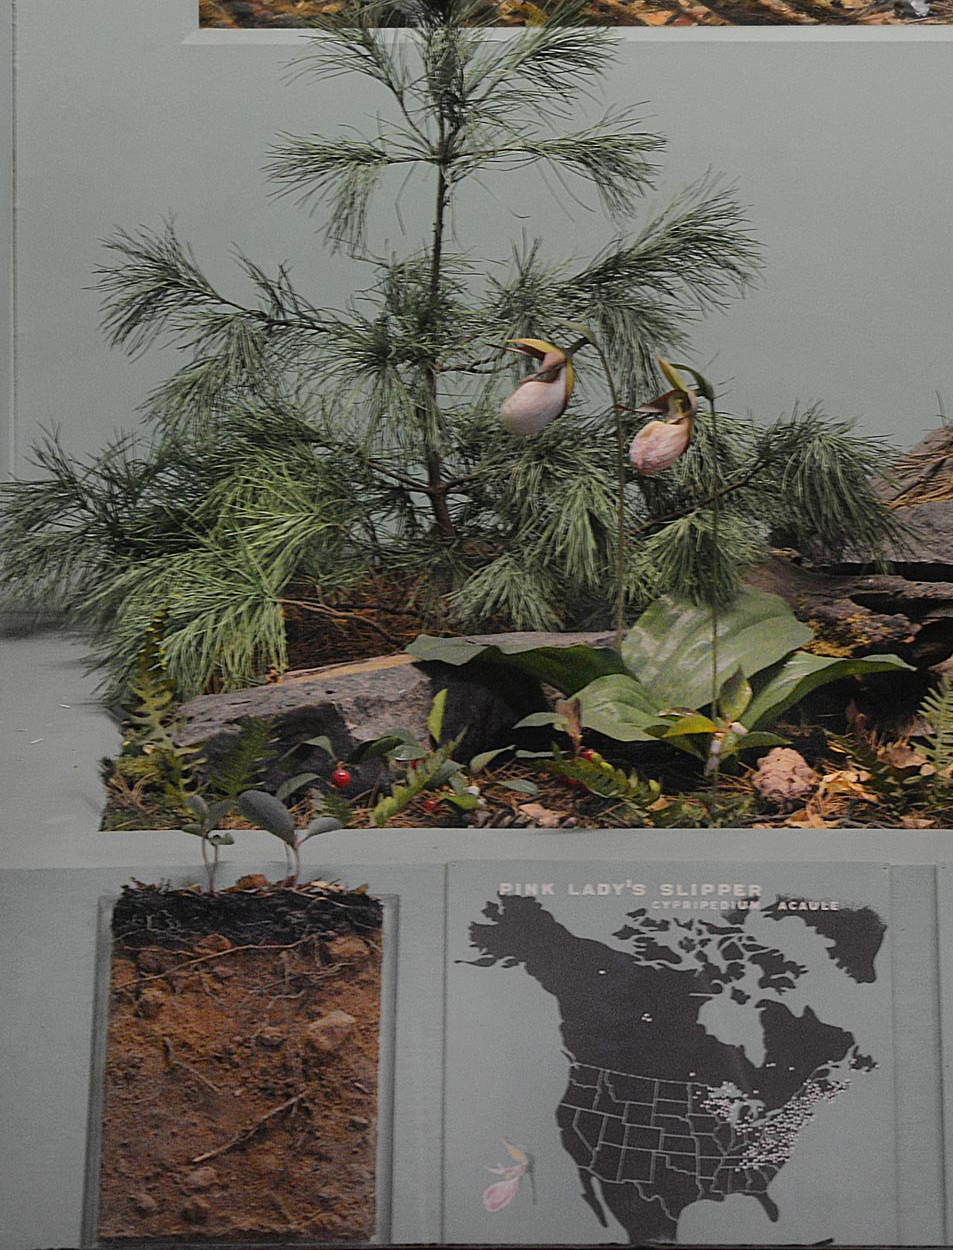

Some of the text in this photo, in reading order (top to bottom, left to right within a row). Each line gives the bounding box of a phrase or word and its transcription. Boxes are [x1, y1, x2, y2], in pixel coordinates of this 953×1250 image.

[498, 879, 763, 897] PINK LADY'S SLIPPER
[651, 900, 841, 912] CYPRIPEDIUM ACAULE
